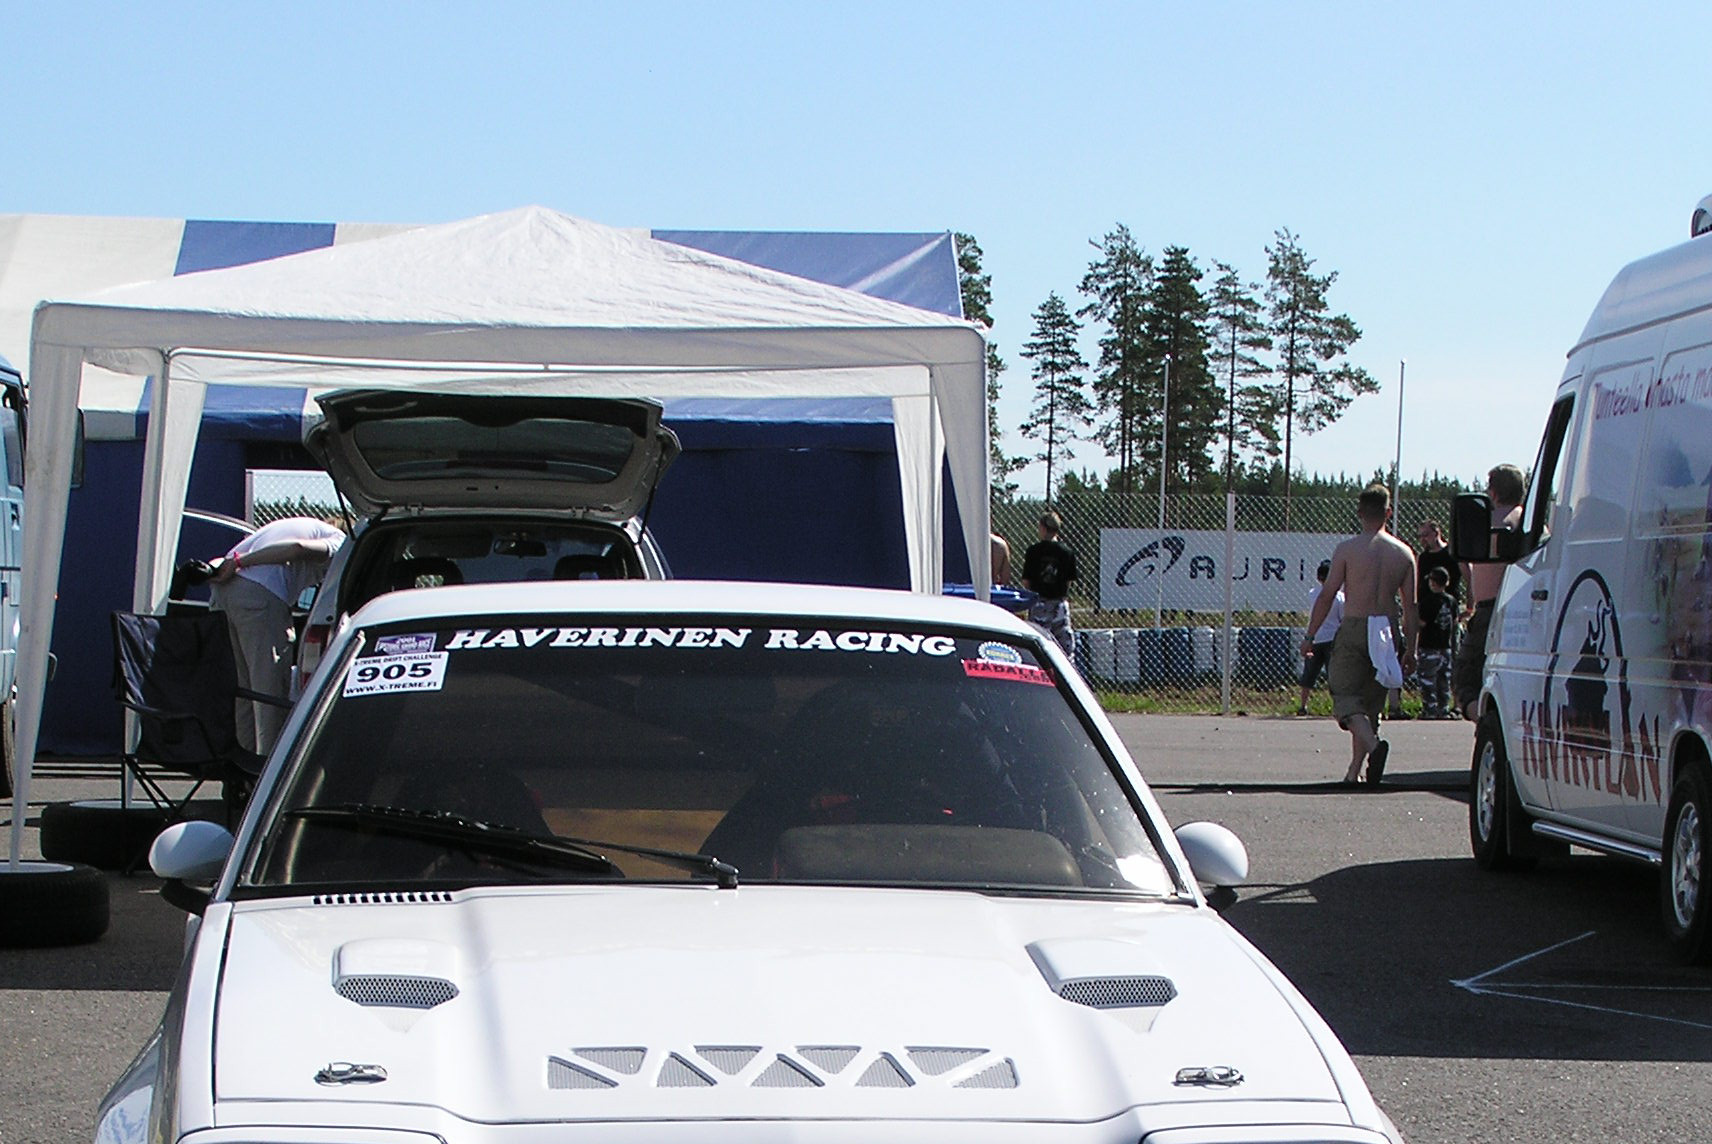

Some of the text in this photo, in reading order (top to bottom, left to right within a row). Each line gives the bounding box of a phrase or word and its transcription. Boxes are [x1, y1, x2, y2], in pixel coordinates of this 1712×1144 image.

[444, 627, 752, 650] HAVERINEN
[763, 629, 958, 657] RACING
[403, 653, 442, 662] CHALLENGE
[356, 662, 432, 683] 905
[345, 681, 437, 694] WWW.X-TREME.FI
